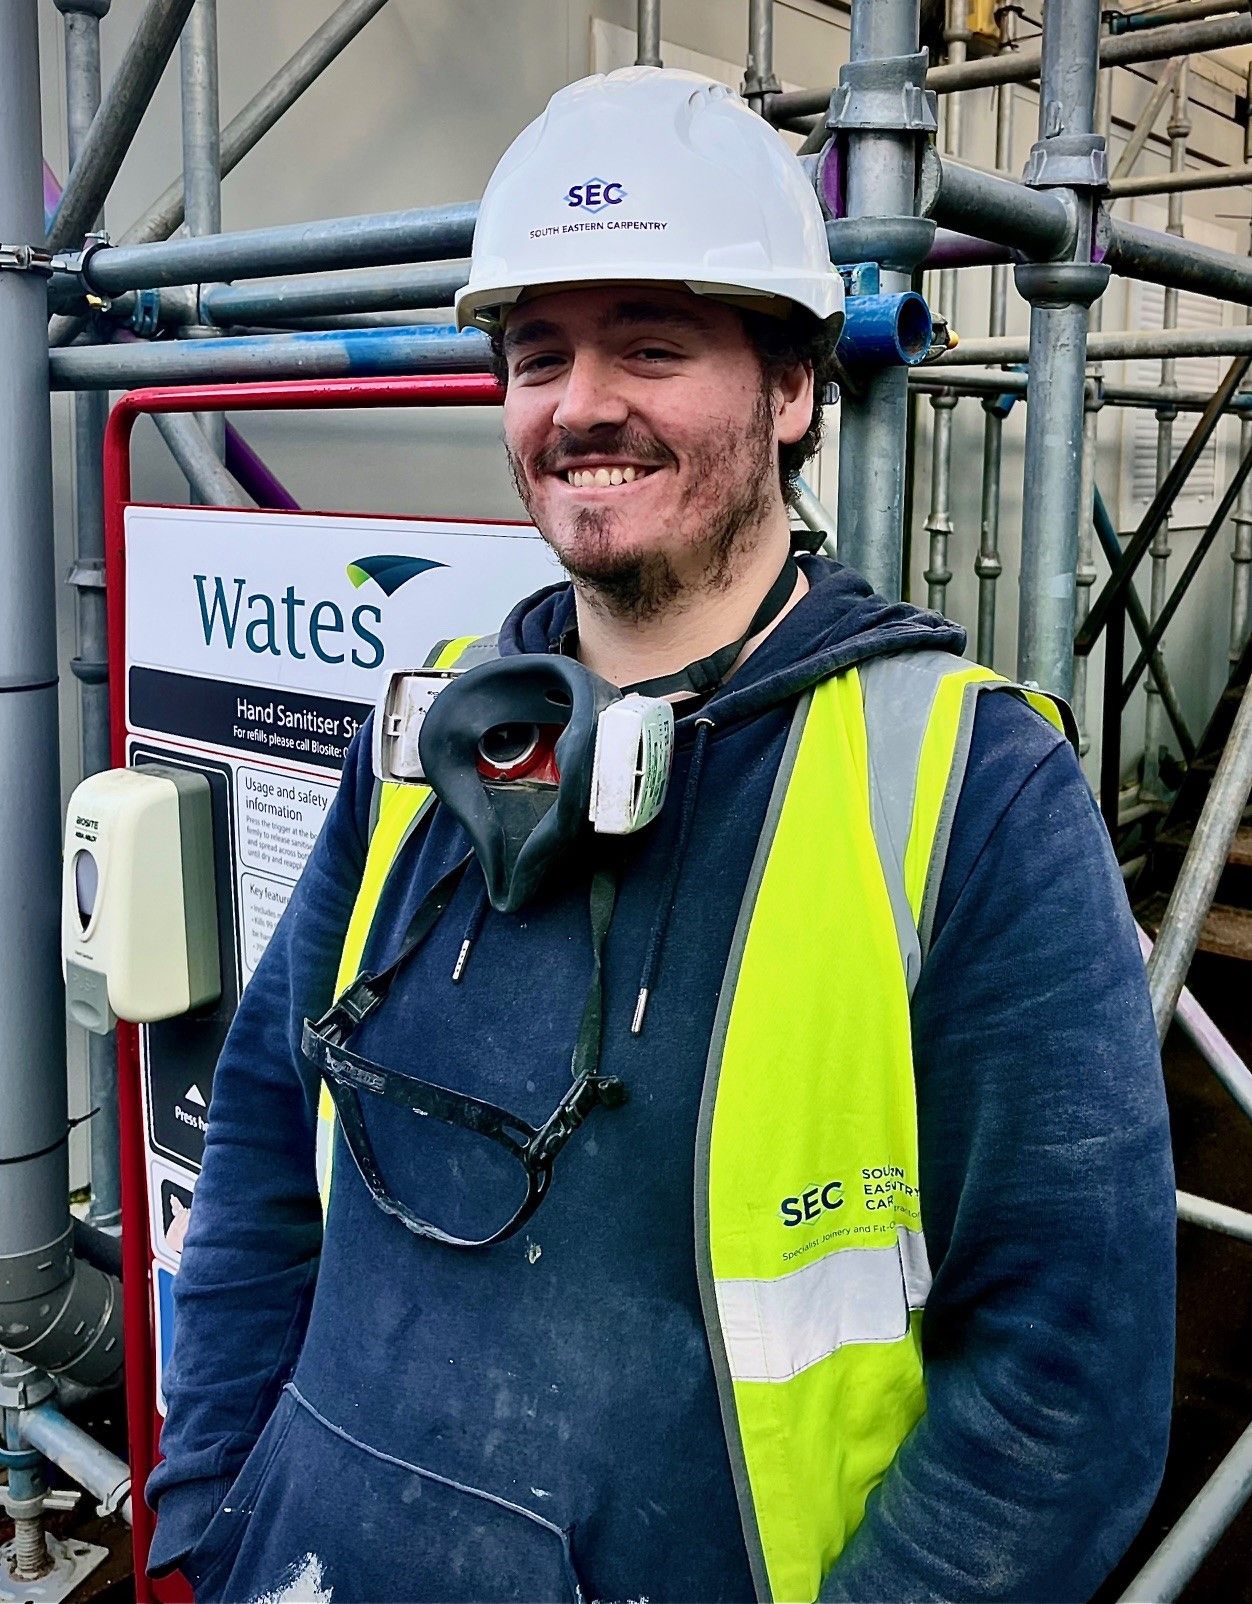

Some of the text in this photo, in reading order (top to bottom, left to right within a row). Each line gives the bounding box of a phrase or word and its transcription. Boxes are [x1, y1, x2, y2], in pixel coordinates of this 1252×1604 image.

[568, 183, 623, 207] SEC
[530, 221, 668, 238] SOUTH EASTERN CARPENTRY
[193, 574, 385, 669] Wates
[237, 697, 363, 738] Hand Sanitiser St
[233, 725, 246, 738] For
[247, 729, 268, 743] refills
[269, 732, 295, 749] please
[296, 738, 310, 751] call
[246, 776, 328, 811] Usage and safety
[246, 795, 303, 822] information
[246, 815, 260, 827] Press
[261, 819, 271, 829] the
[271, 821, 290, 835] trigger
[292, 826, 298, 835] at
[299, 829, 309, 838] the
[263, 830, 270, 840] to
[247, 838, 258, 847] and
[271, 856, 283, 865] and
[249, 883, 263, 900] Key
[174, 1105, 198, 1128] Press
[781, 1181, 844, 1226] SEC
[782, 1238, 821, 1261] Specialist
[821, 1227, 851, 1243] Joinery
[853, 1224, 871, 1234] and
